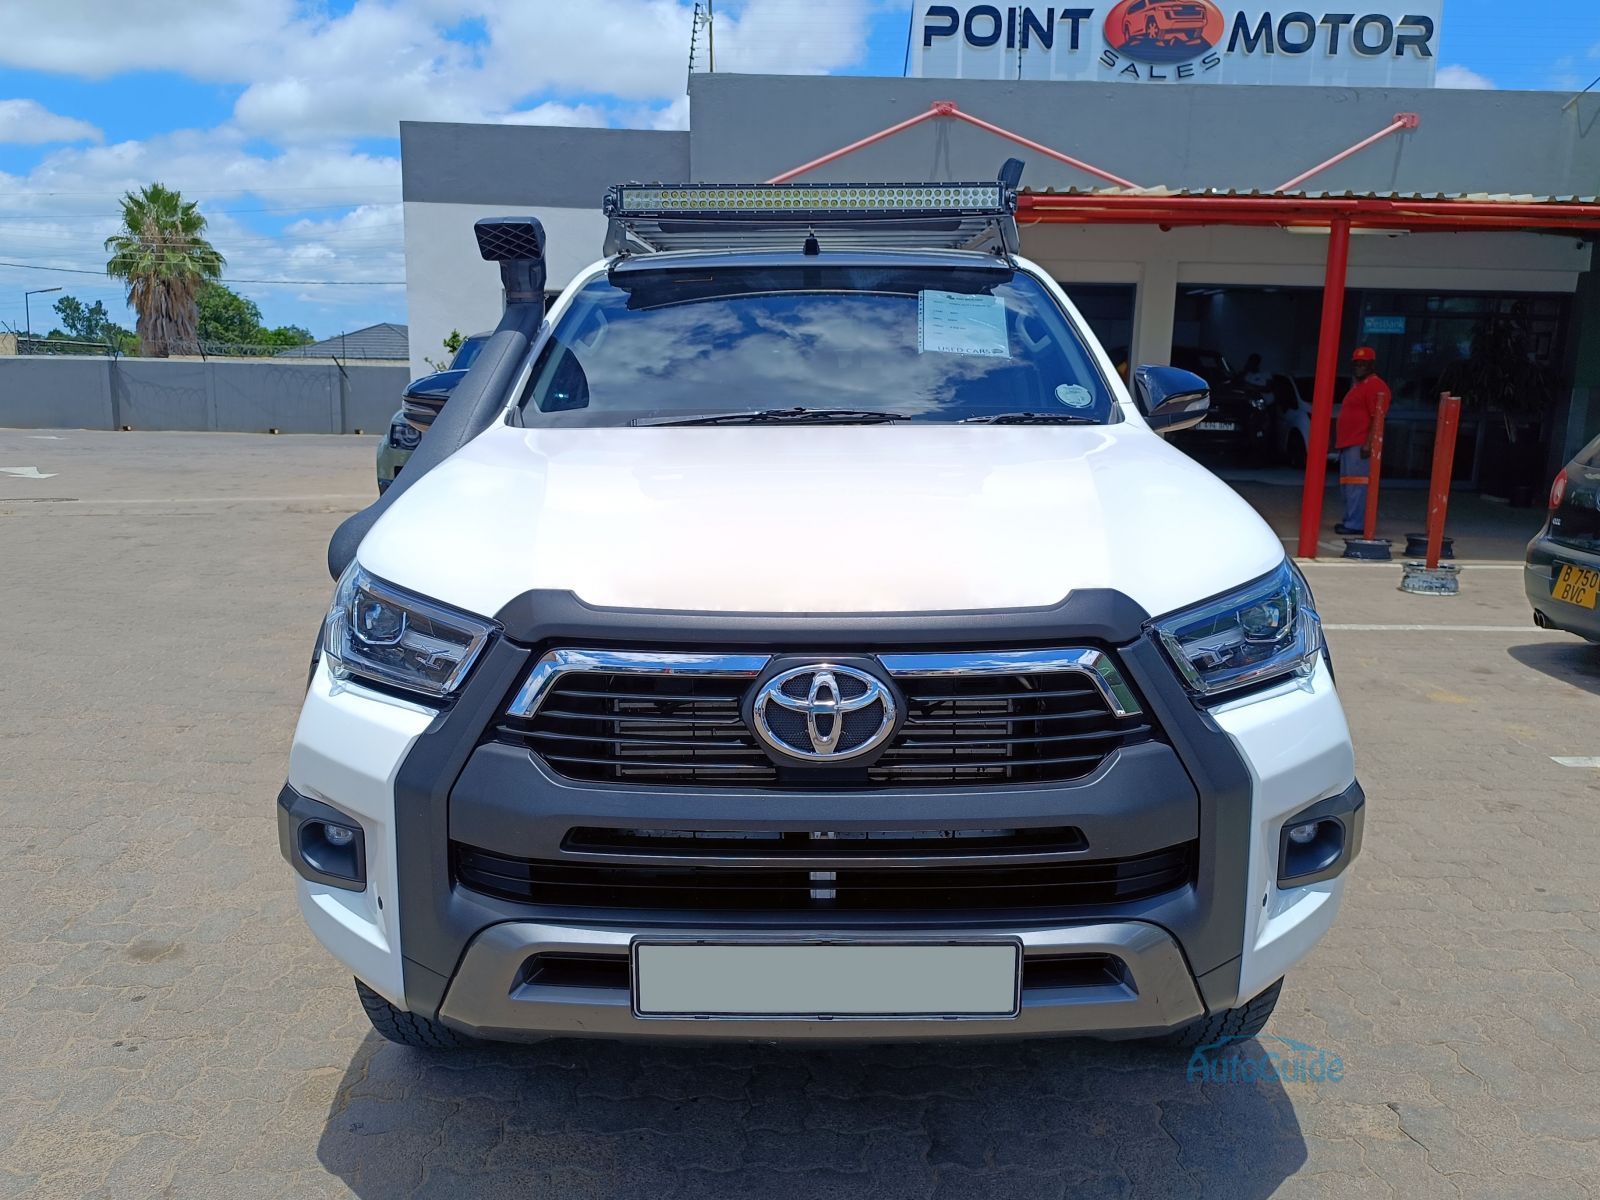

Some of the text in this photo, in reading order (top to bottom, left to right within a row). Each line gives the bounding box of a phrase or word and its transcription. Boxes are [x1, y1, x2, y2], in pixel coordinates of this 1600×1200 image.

[924, 5, 1435, 58] POINT MOTOR
[1098, 49, 1222, 81] SALES
[1563, 566, 1599, 588] B 750
[1562, 583, 1586, 604] BVC
